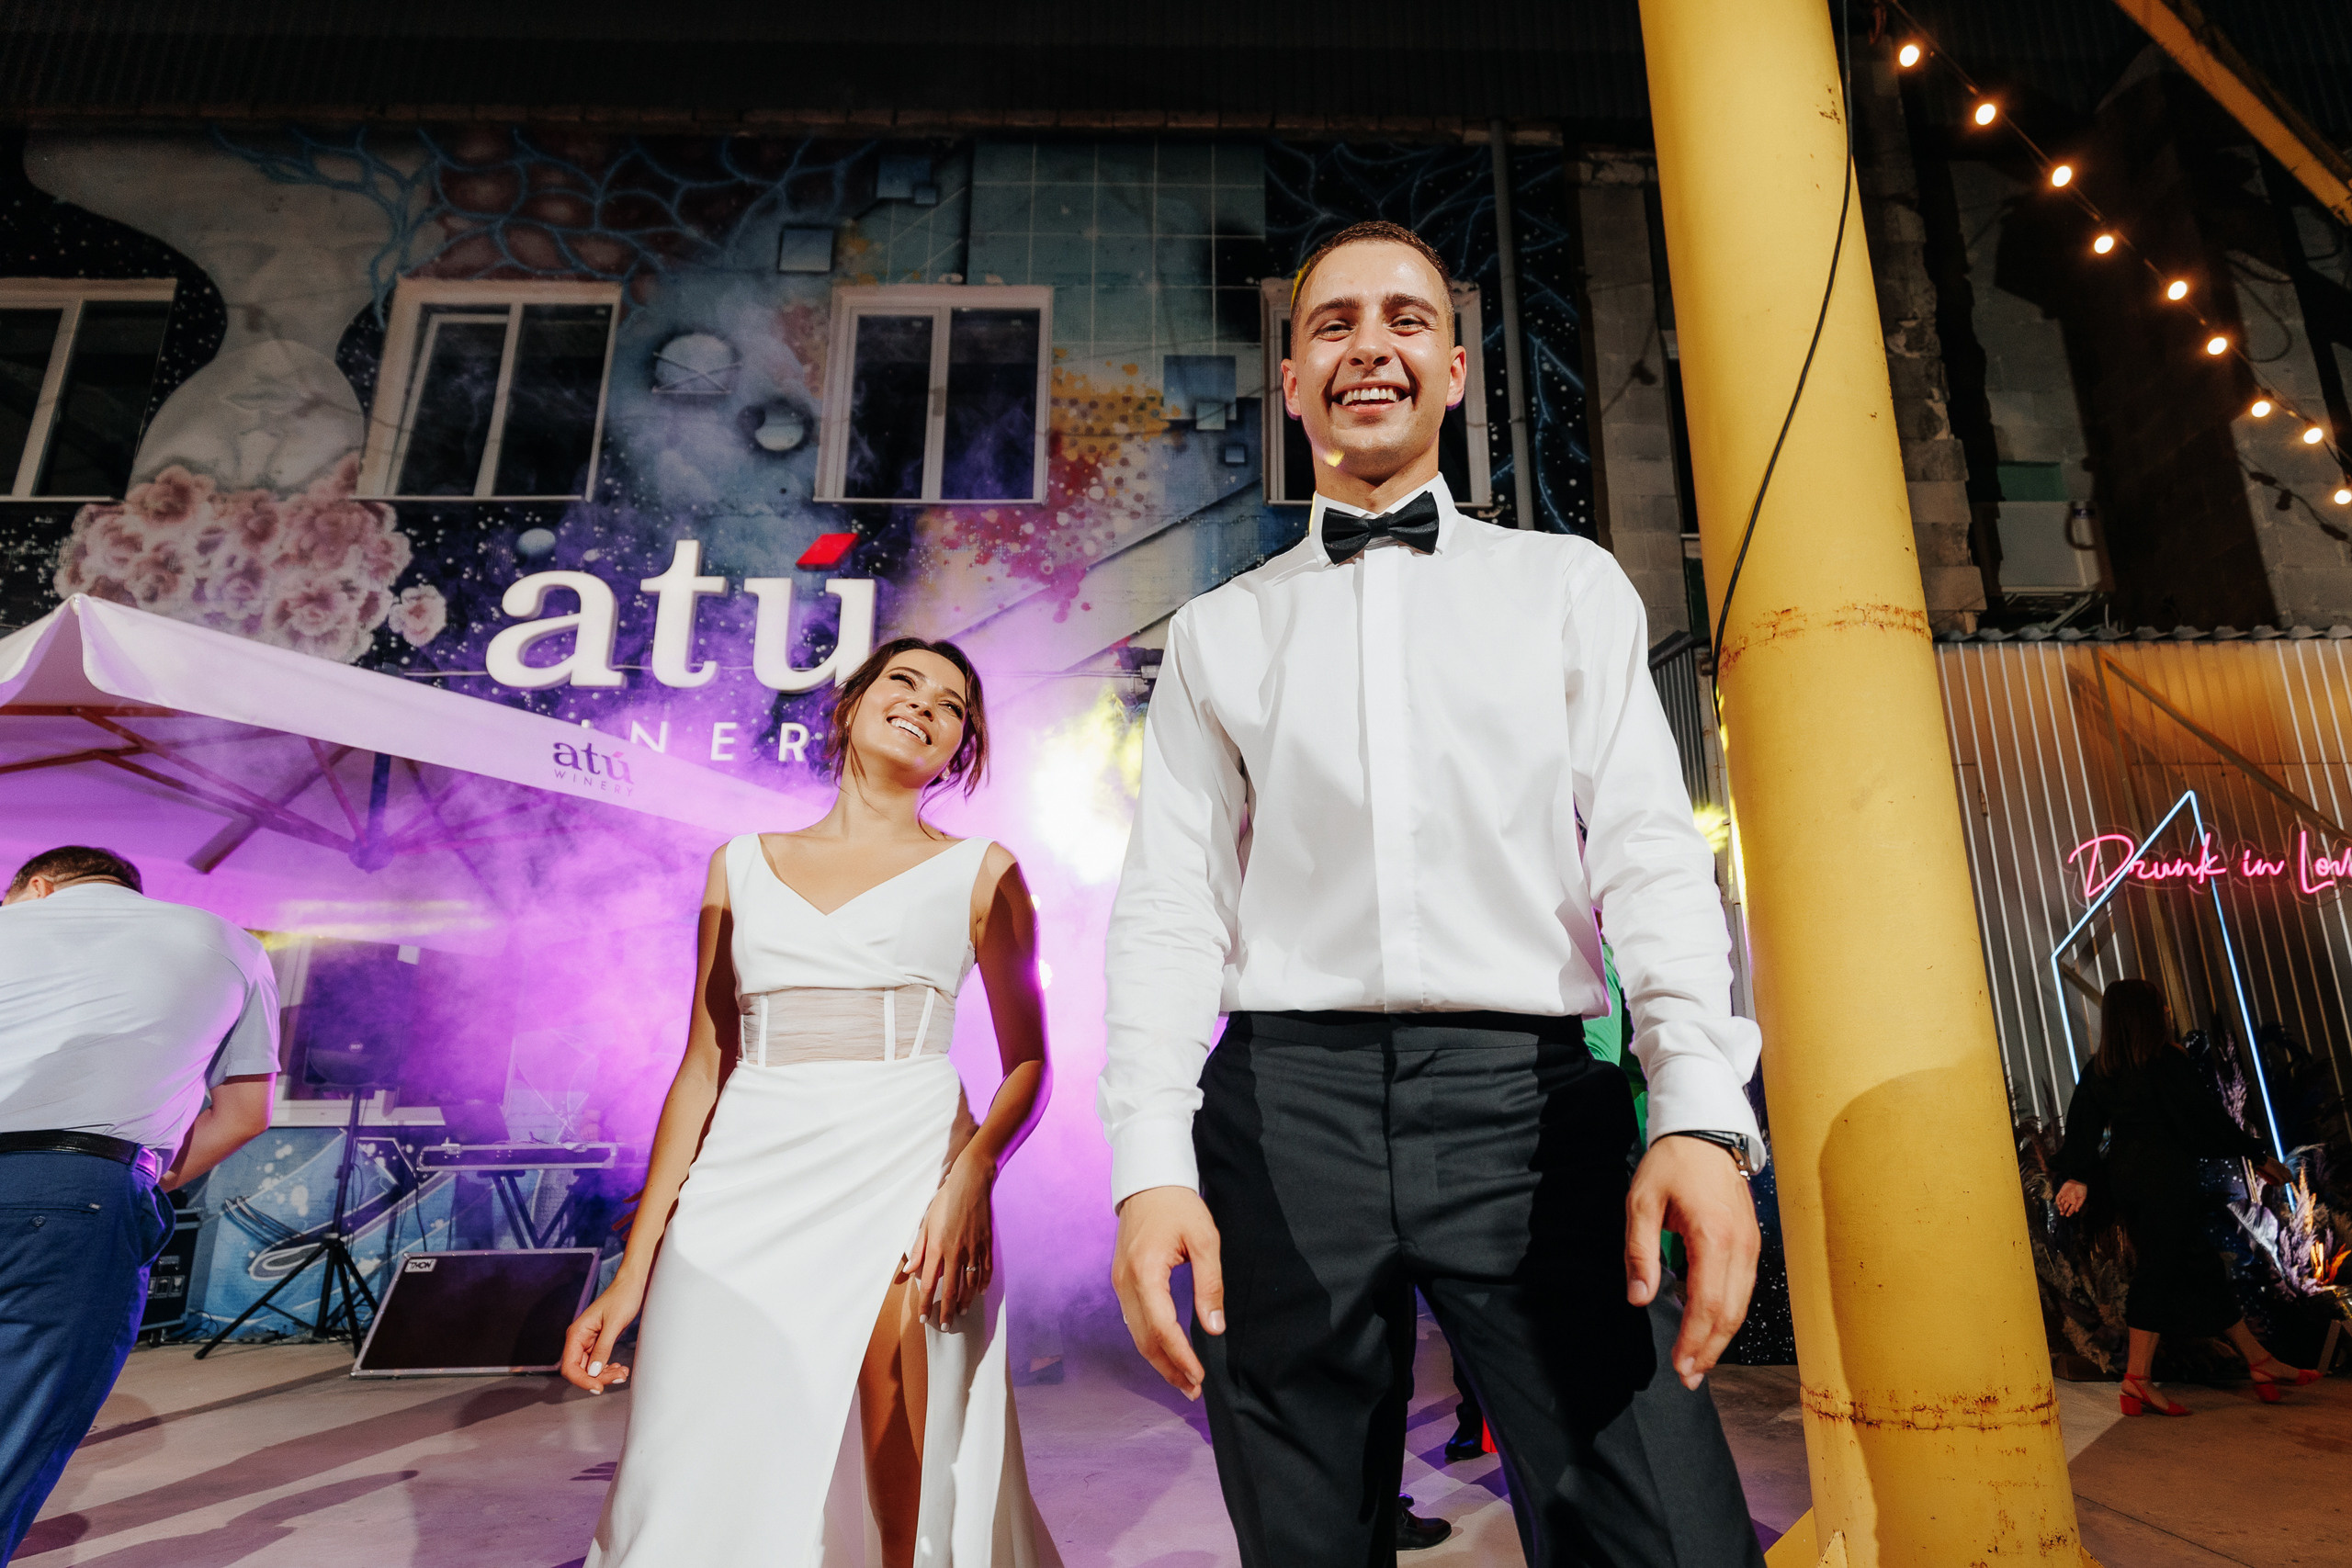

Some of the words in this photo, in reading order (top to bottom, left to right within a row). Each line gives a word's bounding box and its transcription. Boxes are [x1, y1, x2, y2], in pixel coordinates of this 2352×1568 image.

[485, 533, 876, 694] atú
[580, 719, 811, 762] NER
[553, 741, 634, 784] atú
[554, 768, 633, 796] WINERY
[2067, 832, 2227, 897] Drunk
[2242, 849, 2285, 877] in
[2299, 829, 2352, 895] Lov
